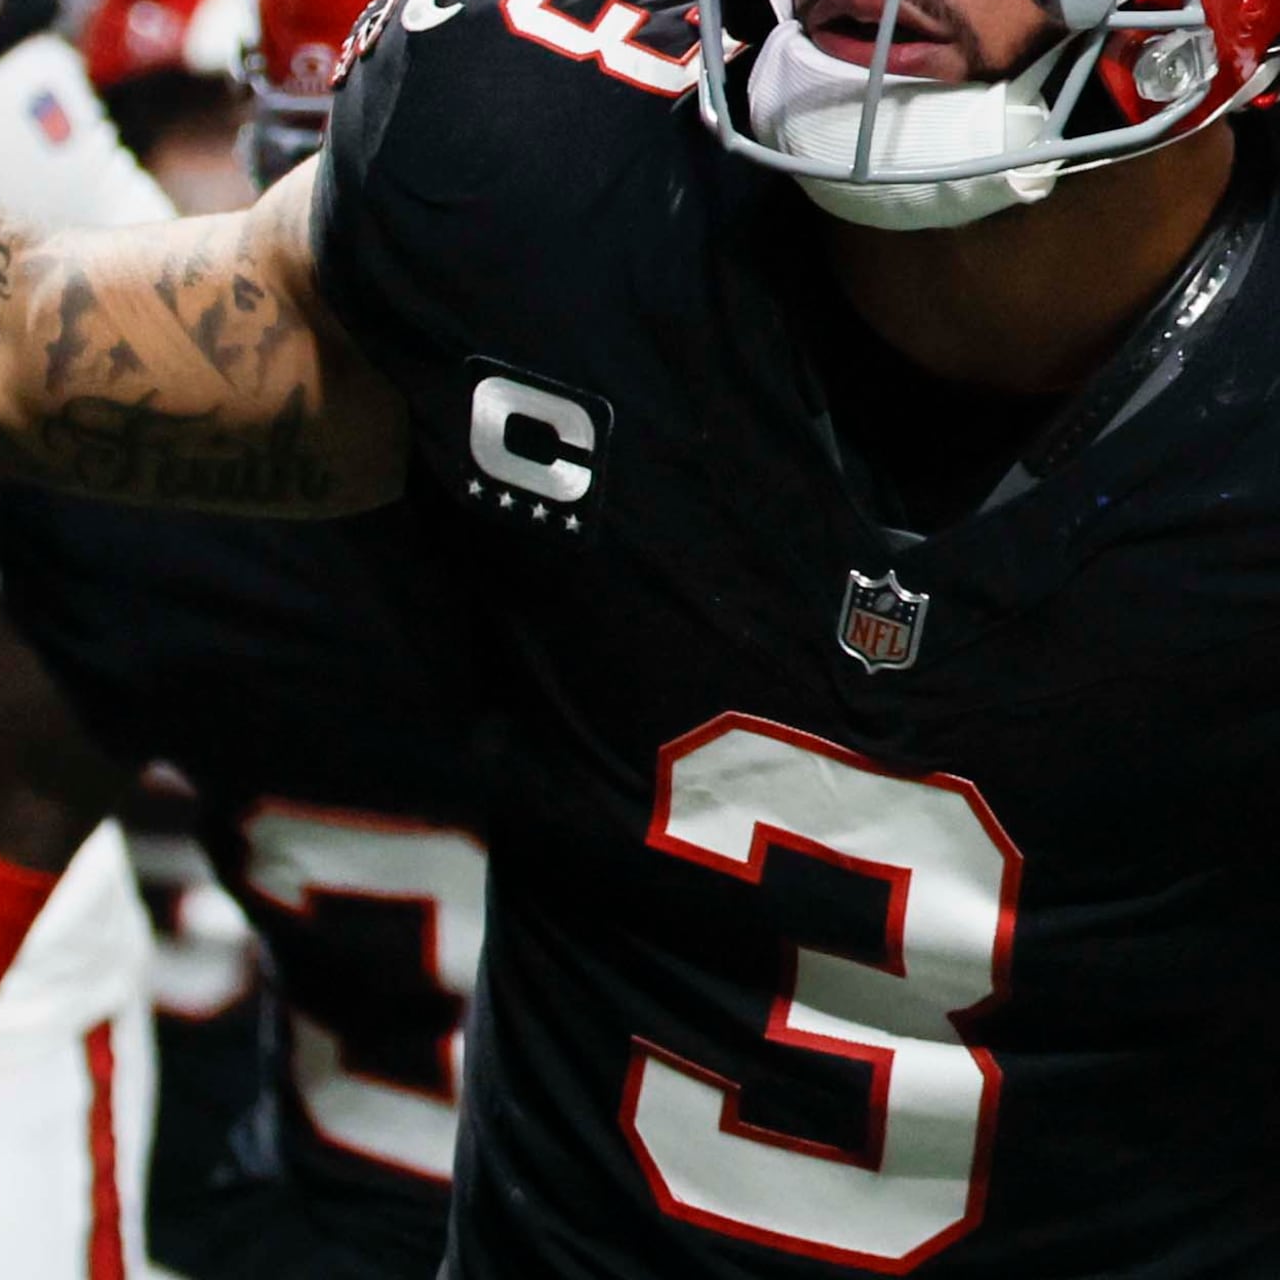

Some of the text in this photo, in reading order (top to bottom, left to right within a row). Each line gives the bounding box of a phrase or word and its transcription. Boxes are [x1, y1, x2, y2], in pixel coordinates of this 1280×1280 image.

[470, 376, 595, 503] C
[849, 612, 907, 658] NFL
[618, 710, 1023, 1275] 3
